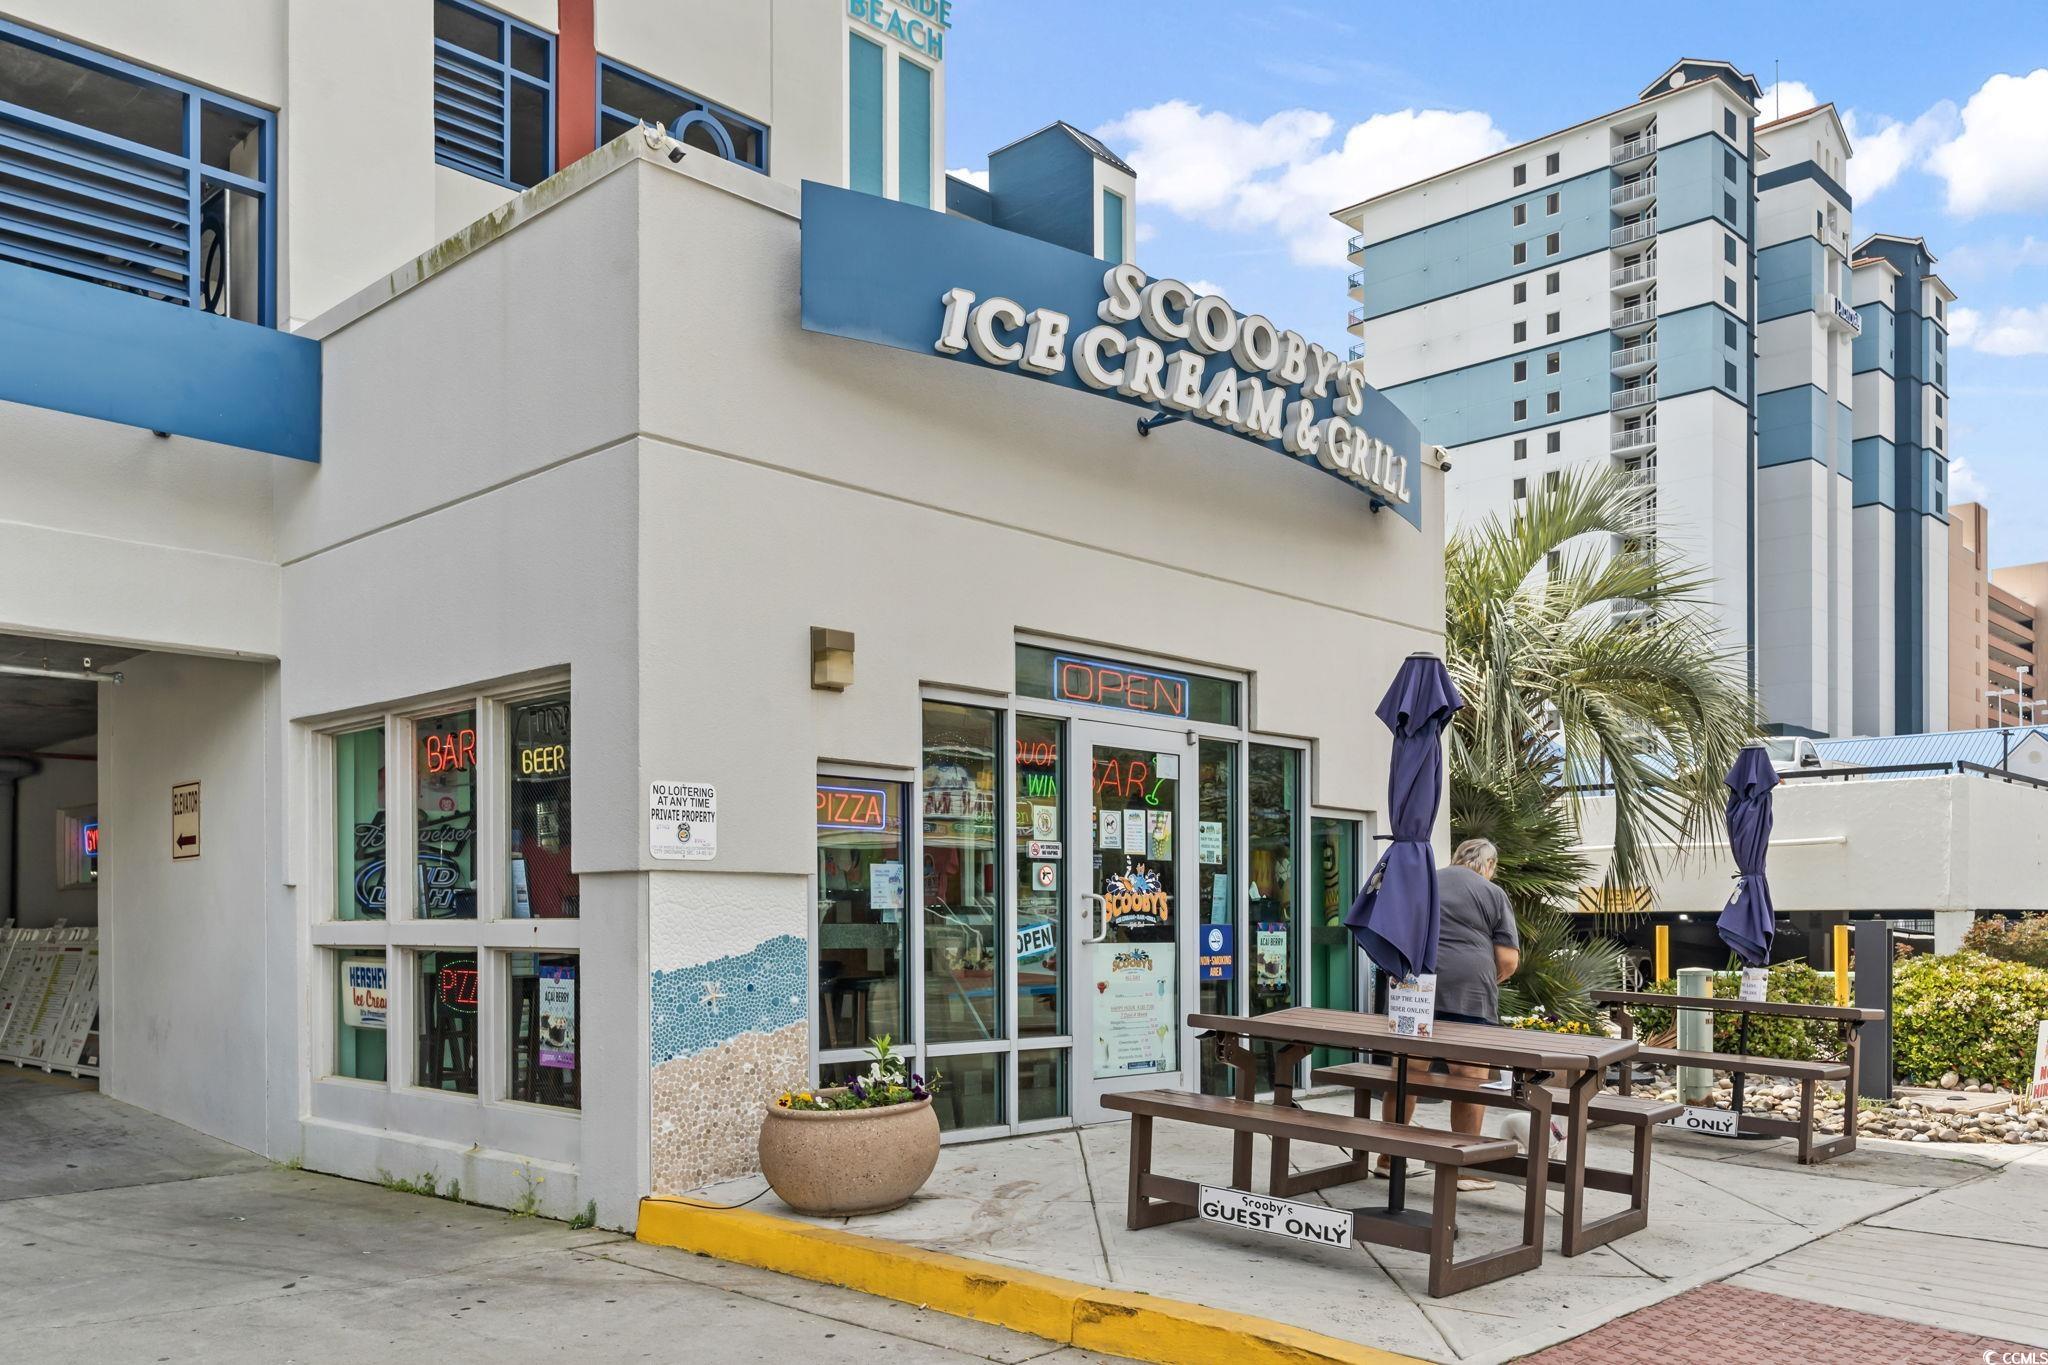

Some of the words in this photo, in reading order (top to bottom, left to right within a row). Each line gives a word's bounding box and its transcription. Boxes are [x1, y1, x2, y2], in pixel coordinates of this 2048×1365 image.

[850, 0, 942, 60] BEACH
[1097, 263, 1365, 417] SCOOBY'S
[934, 287, 1069, 375] ICE
[1072, 326, 1287, 440] CREAM
[1282, 400, 1319, 457] &
[1316, 415, 1411, 504] GRILL
[1063, 664, 1181, 714] OPEN
[427, 729, 476, 772] BAR
[522, 745, 565, 774] BEER
[174, 790, 198, 815] ELEVATOR
[653, 785, 666, 794] NO
[668, 786, 714, 798] LOITERING
[657, 796, 668, 806] AT
[670, 797, 688, 807] ANY
[690, 798, 710, 808] TIME
[651, 808, 680, 821] PRIVATE
[682, 810, 715, 823] PROPERTY
[817, 792, 881, 824] PIZZA
[87, 830, 98, 851] GY
[1017, 927, 1051, 954] OPEN
[1270, 937, 1283, 946] BERRY
[1209, 966, 1222, 977] AREA
[353, 987, 364, 1006] Ice
[556, 991, 569, 1003] BERRY
[1686, 1117, 1733, 1132] ONLY
[1241, 1196, 1293, 1216] Scooby's
[1203, 1202, 1274, 1229] GUEST
[1285, 1219, 1347, 1243] ONLY
